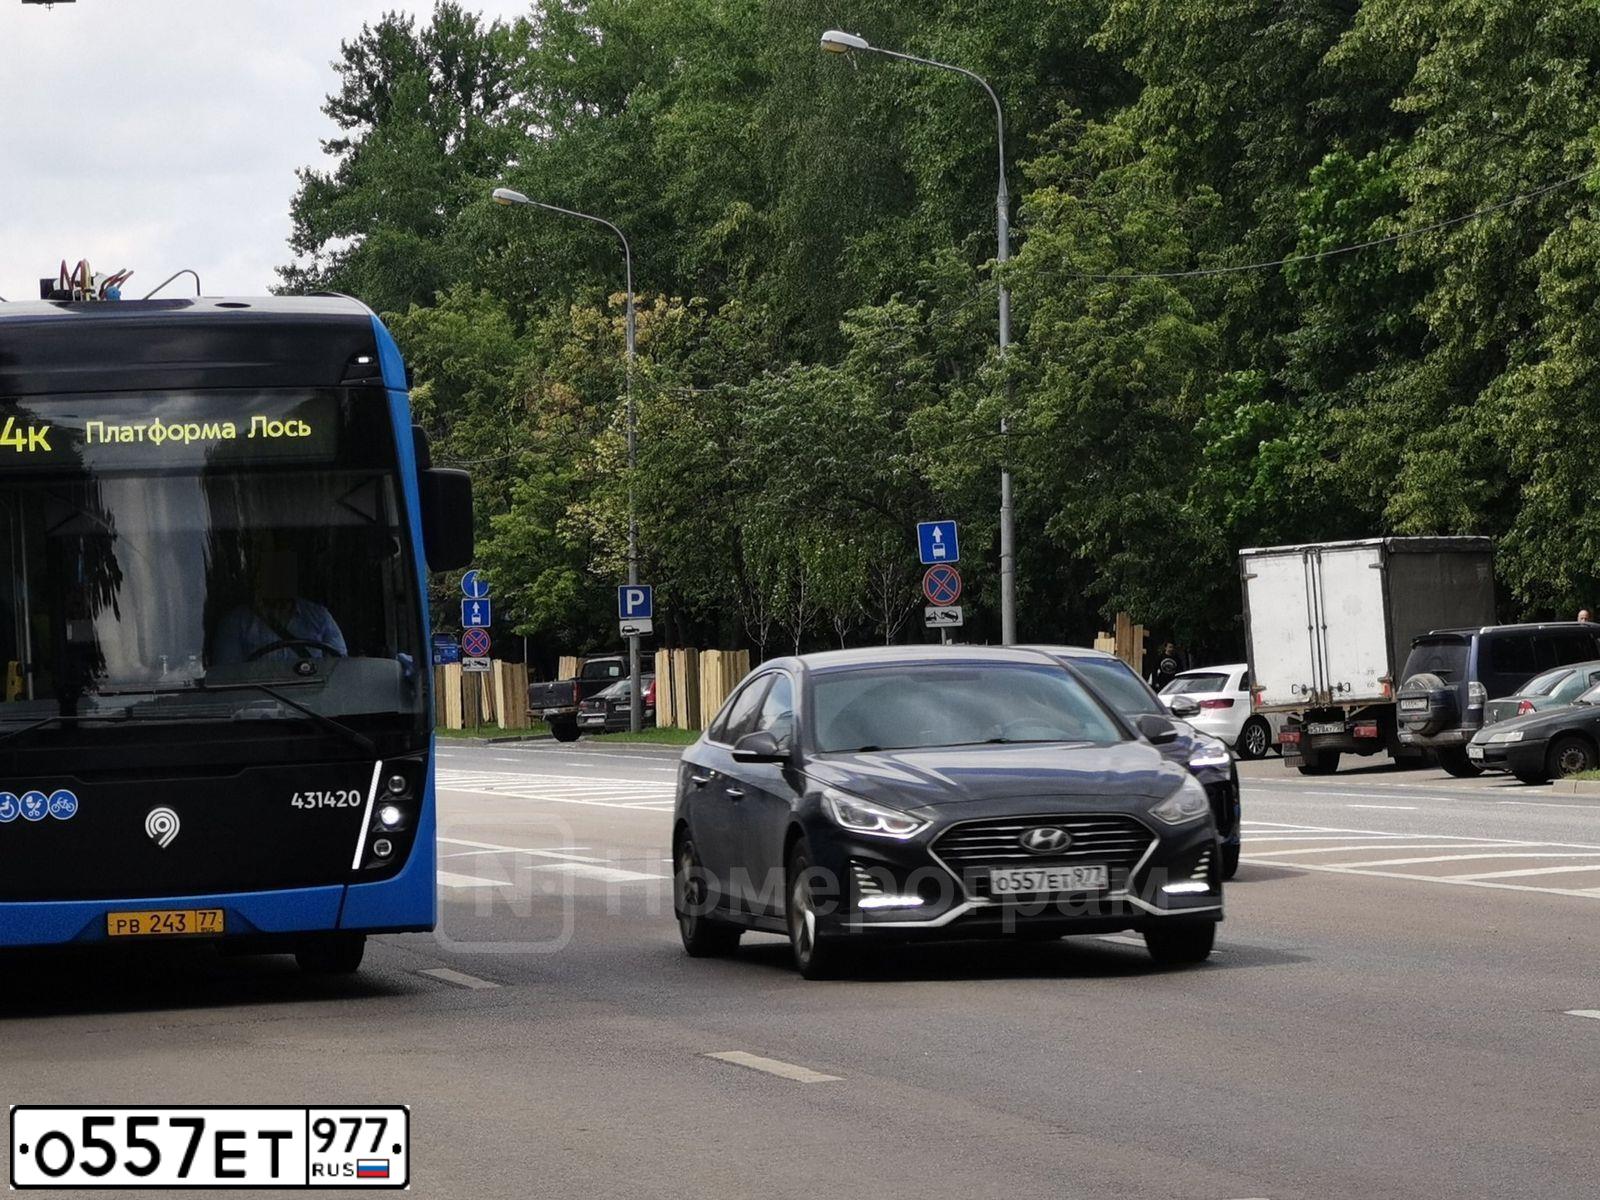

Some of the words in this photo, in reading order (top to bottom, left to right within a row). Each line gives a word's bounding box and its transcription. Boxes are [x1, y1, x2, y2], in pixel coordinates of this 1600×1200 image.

[86, 417, 236, 446] Платформа
[248, 415, 312, 438] Лось
[626, 589, 645, 615] P
[291, 789, 361, 809] 431420
[150, 913, 186, 933] 243
[198, 911, 217, 926] 77
